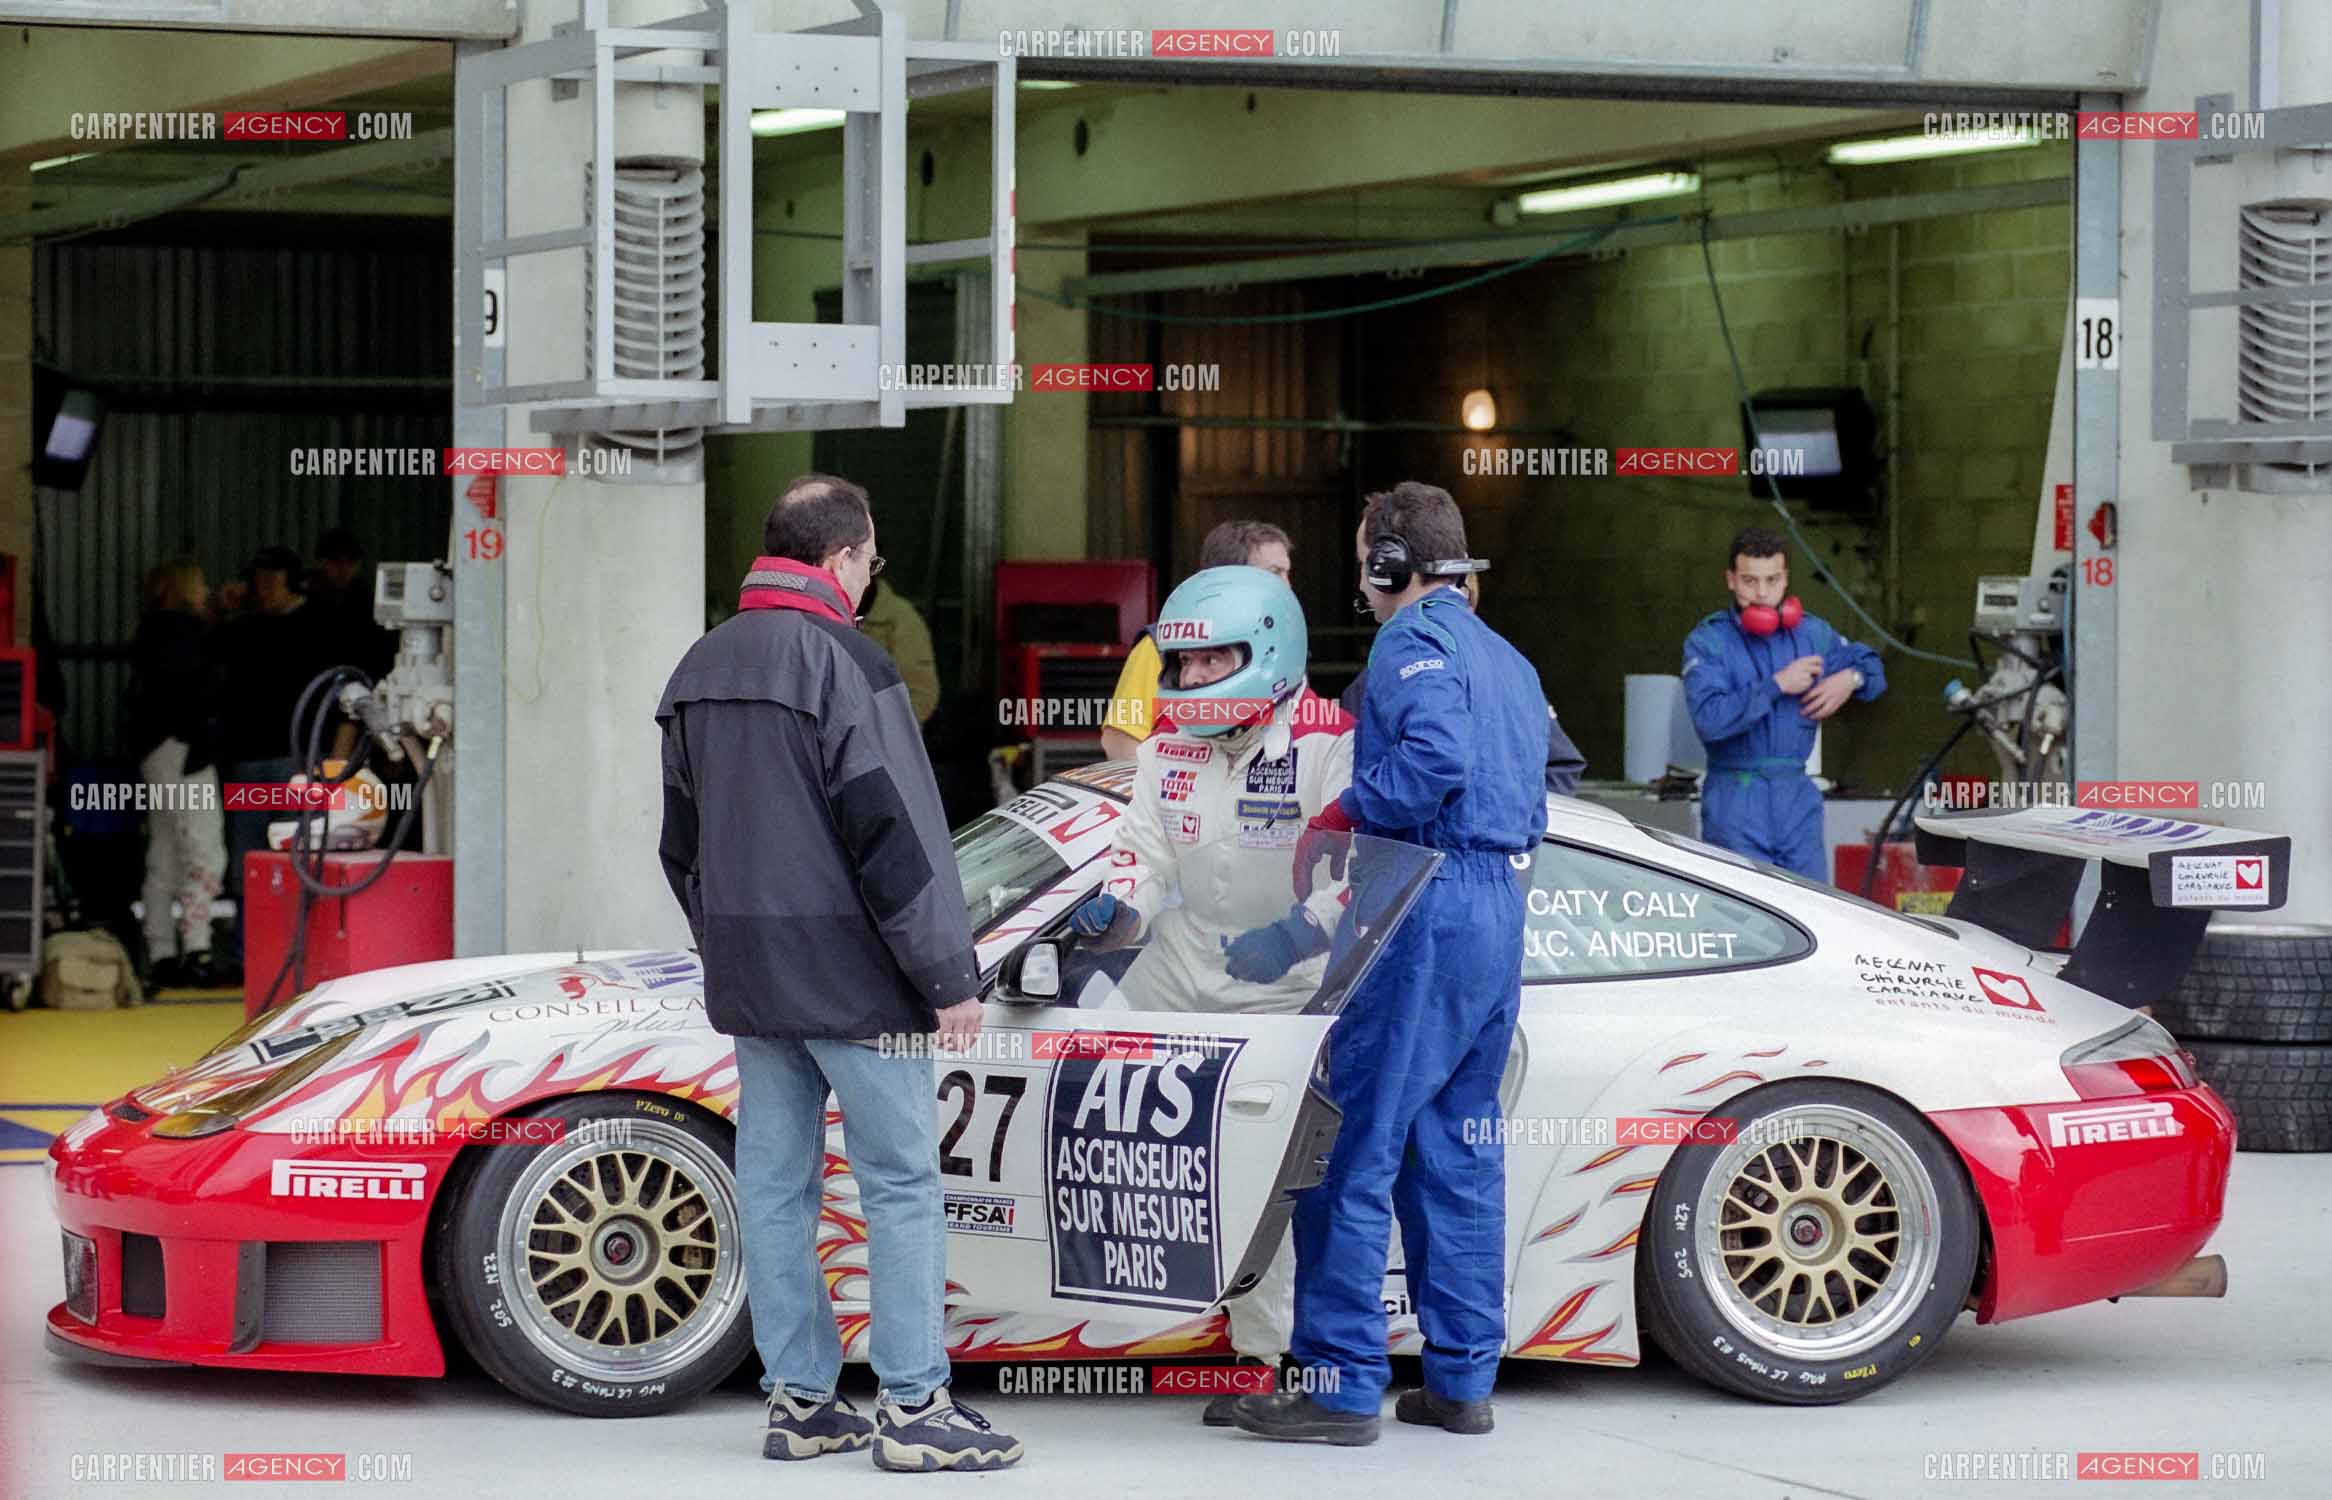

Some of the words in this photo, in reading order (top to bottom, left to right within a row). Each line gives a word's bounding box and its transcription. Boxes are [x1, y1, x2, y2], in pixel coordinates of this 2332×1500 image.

[484, 289, 498, 336] 9
[2082, 317, 2113, 359] 18
[464, 527, 505, 560] 19
[2082, 556, 2113, 588] 18
[1158, 621, 1210, 640] TOTAL
[1161, 778, 1196, 793] TOTAL
[1526, 888, 1609, 916] CATY
[1622, 891, 1700, 918] CALY
[1523, 930, 1576, 958] J.C.
[1587, 932, 1738, 960] ANDRUET
[489, 999, 645, 1023] CONSEIL
[1072, 1047, 1206, 1138] ATS
[936, 1069, 1029, 1183] 27
[2047, 1102, 2179, 1148] PIRELLI
[270, 1158, 428, 1201] PIRELLI
[1056, 1136, 1208, 1193] ASCENSEURS
[944, 1202, 1006, 1225] FFSA
[1056, 1186, 1107, 1234] SUR
[1112, 1191, 1210, 1244] MESURE
[1103, 1240, 1168, 1291] PARIS
